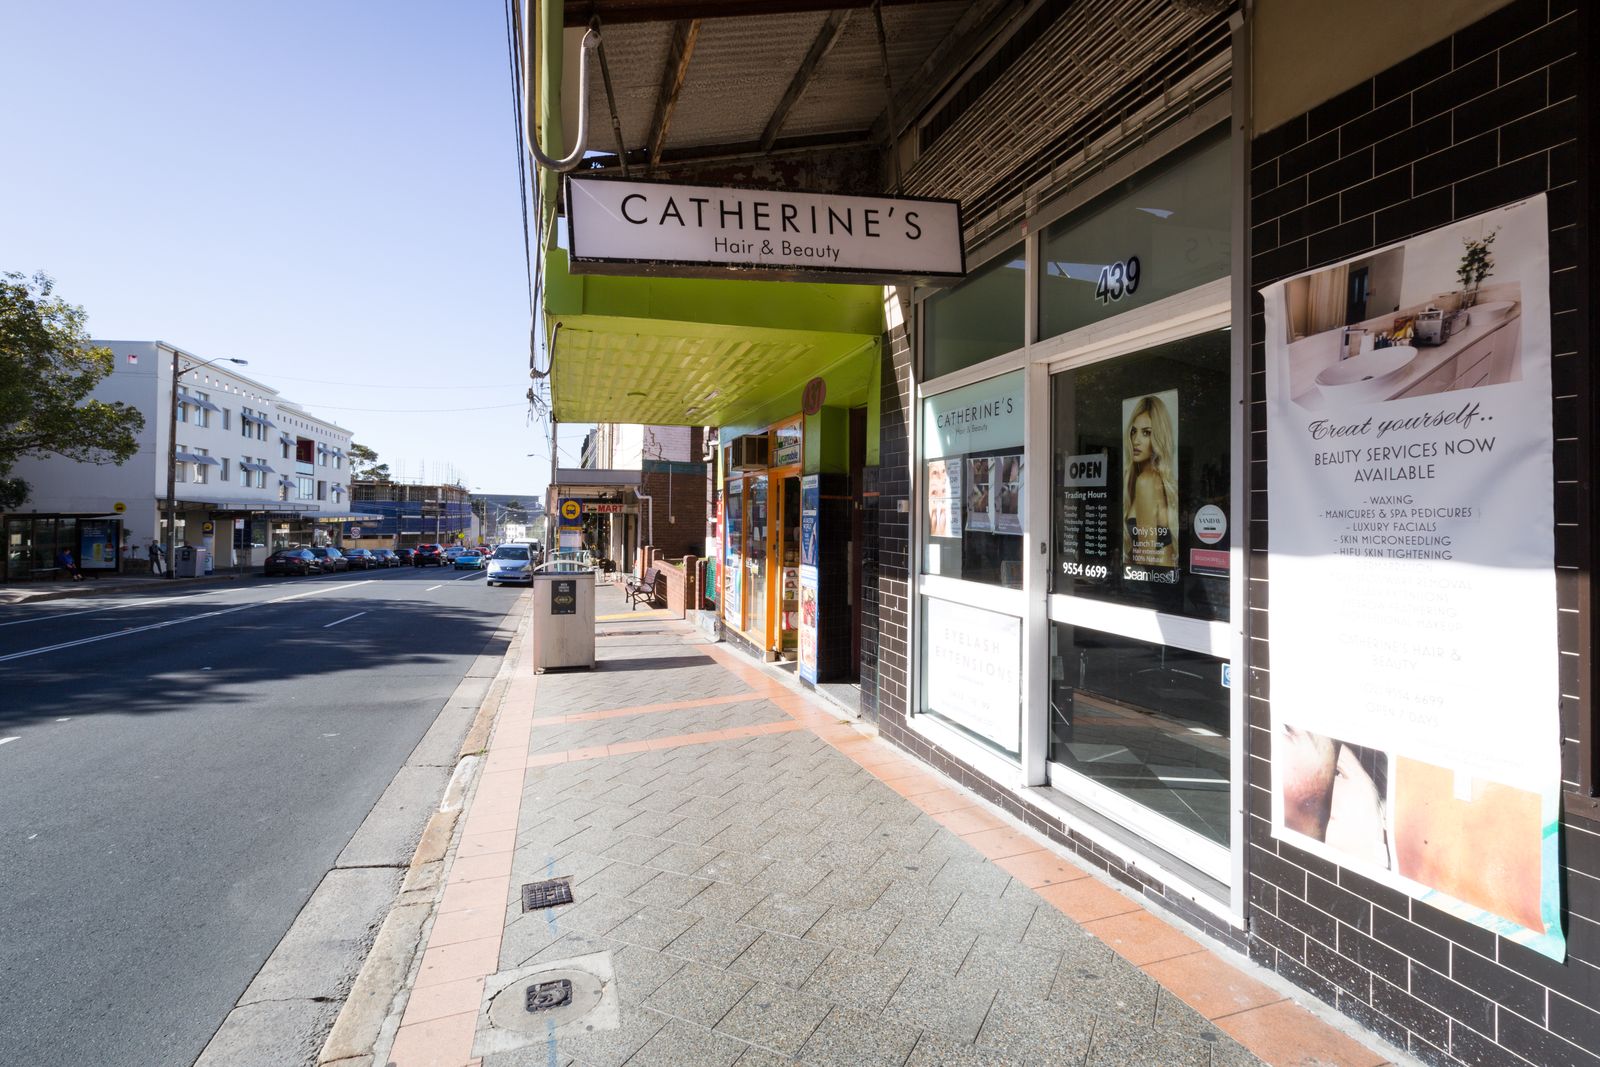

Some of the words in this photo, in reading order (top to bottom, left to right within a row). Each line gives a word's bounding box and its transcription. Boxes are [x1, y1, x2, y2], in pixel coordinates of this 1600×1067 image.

[621, 193, 922, 240] CATHERINE'S
[714, 237, 754, 255] Hair
[761, 239, 775, 256] &
[782, 240, 840, 263] Beauty
[1095, 255, 1140, 305] 439
[937, 397, 1013, 428] CATHERINE'S
[1308, 416, 1373, 440] Treat
[1314, 449, 1361, 466] BEAUTY
[1366, 442, 1437, 462] SERVICES
[1445, 437, 1496, 455] NOW
[1069, 461, 1102, 479] OPEN
[1354, 464, 1435, 483] AVAILABLE
[1064, 491, 1086, 500] Trading
[1087, 490, 1107, 498] Hours
[1369, 495, 1413, 505] WAXING
[1325, 509, 1375, 519] MANICURES
[1379, 509, 1387, 518] &
[1390, 508, 1408, 518] SPA
[1411, 507, 1472, 518] PEDICURES
[1132, 526, 1148, 537] Only
[1353, 522, 1389, 532] LUXURY
[1393, 522, 1437, 532] FACIALS
[1340, 535, 1359, 544] SKIN
[1362, 535, 1451, 546] MICRONEEDLING
[1364, 548, 1383, 557] SKIN
[1387, 549, 1453, 560] TIGHTENING
[1063, 562, 1083, 575] 9554
[1085, 564, 1107, 578] 6699
[1413, 643, 1445, 657] HAIR
[1371, 654, 1417, 670] BEAUTY
